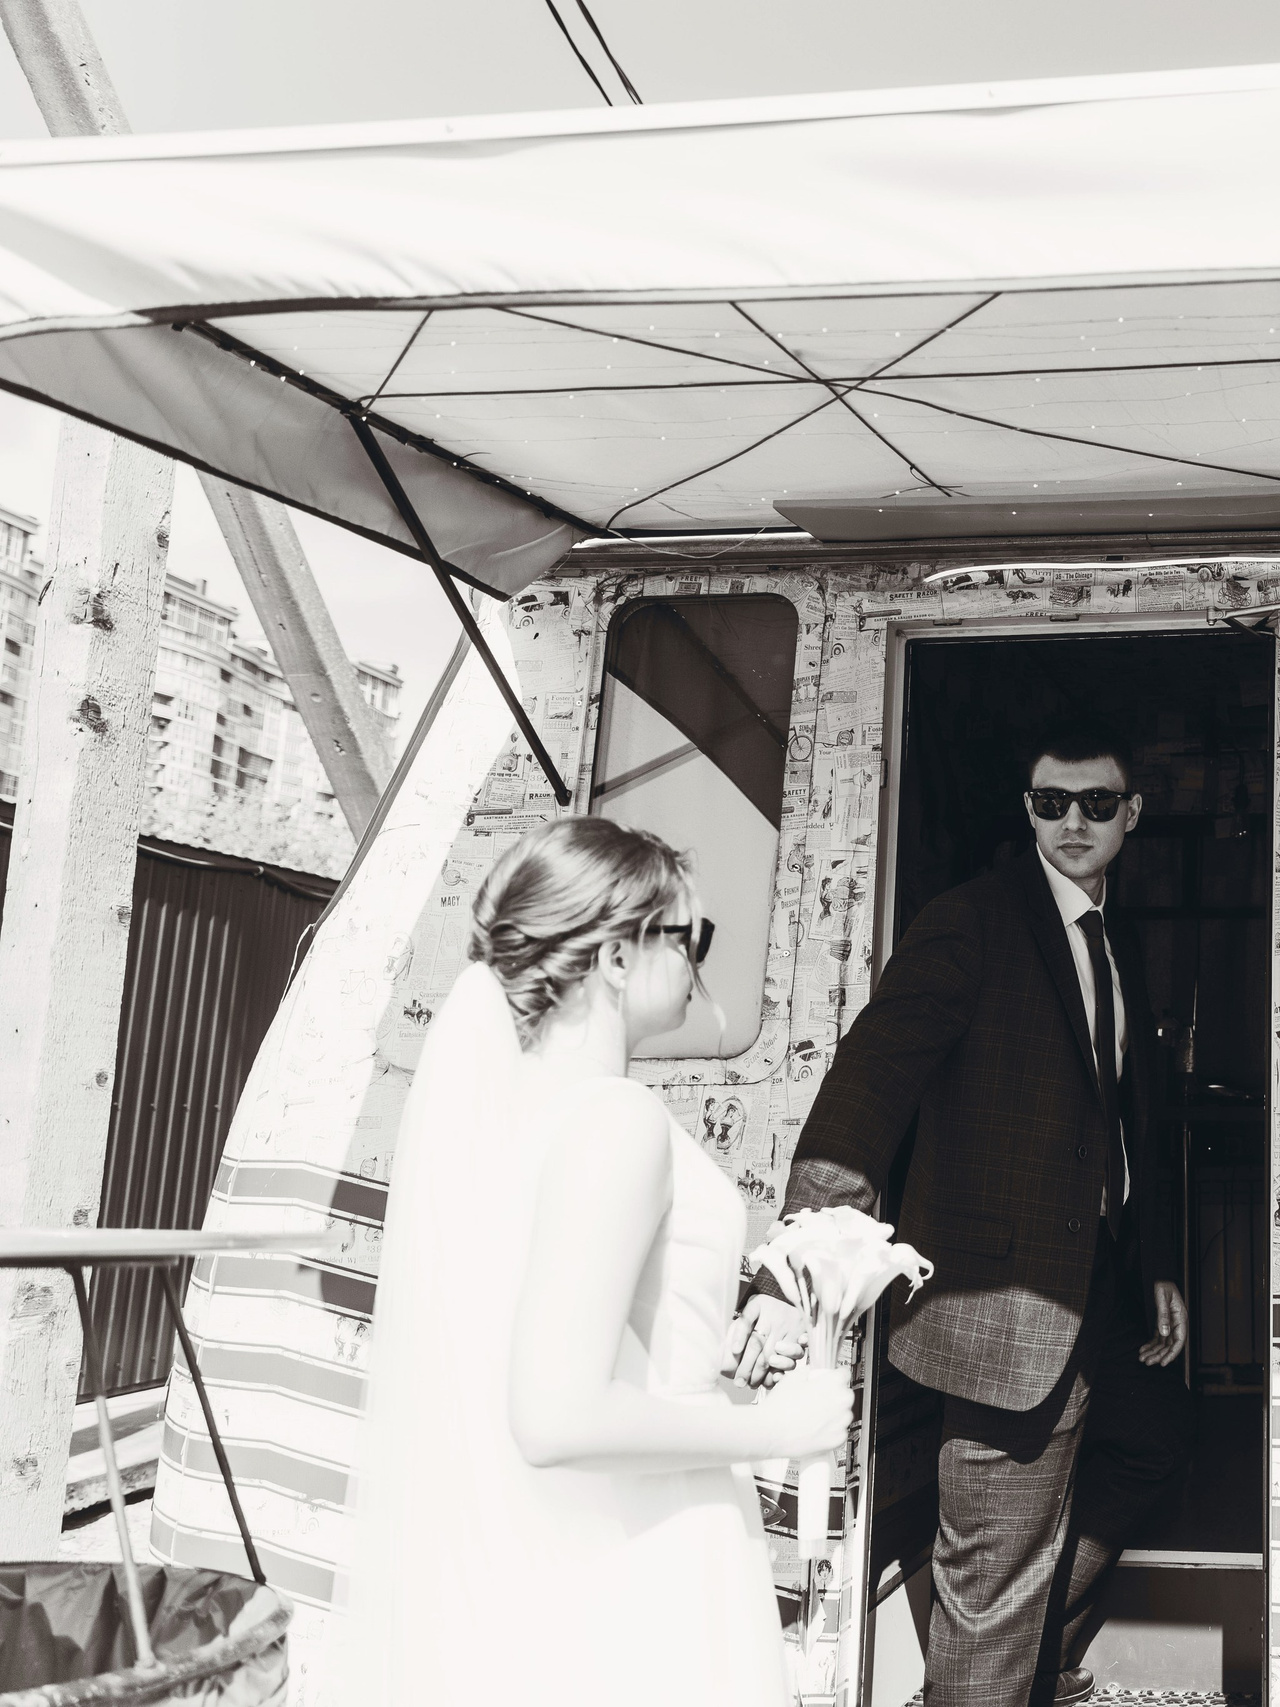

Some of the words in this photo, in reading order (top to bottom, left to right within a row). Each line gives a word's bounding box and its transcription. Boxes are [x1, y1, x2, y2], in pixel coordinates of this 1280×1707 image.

[1066, 572, 1075, 580] The
[1075, 571, 1093, 580] Chicago
[889, 592, 914, 602] SAFETY
[783, 886, 800, 896] FRENCH
[440, 895, 461, 908] MACY
